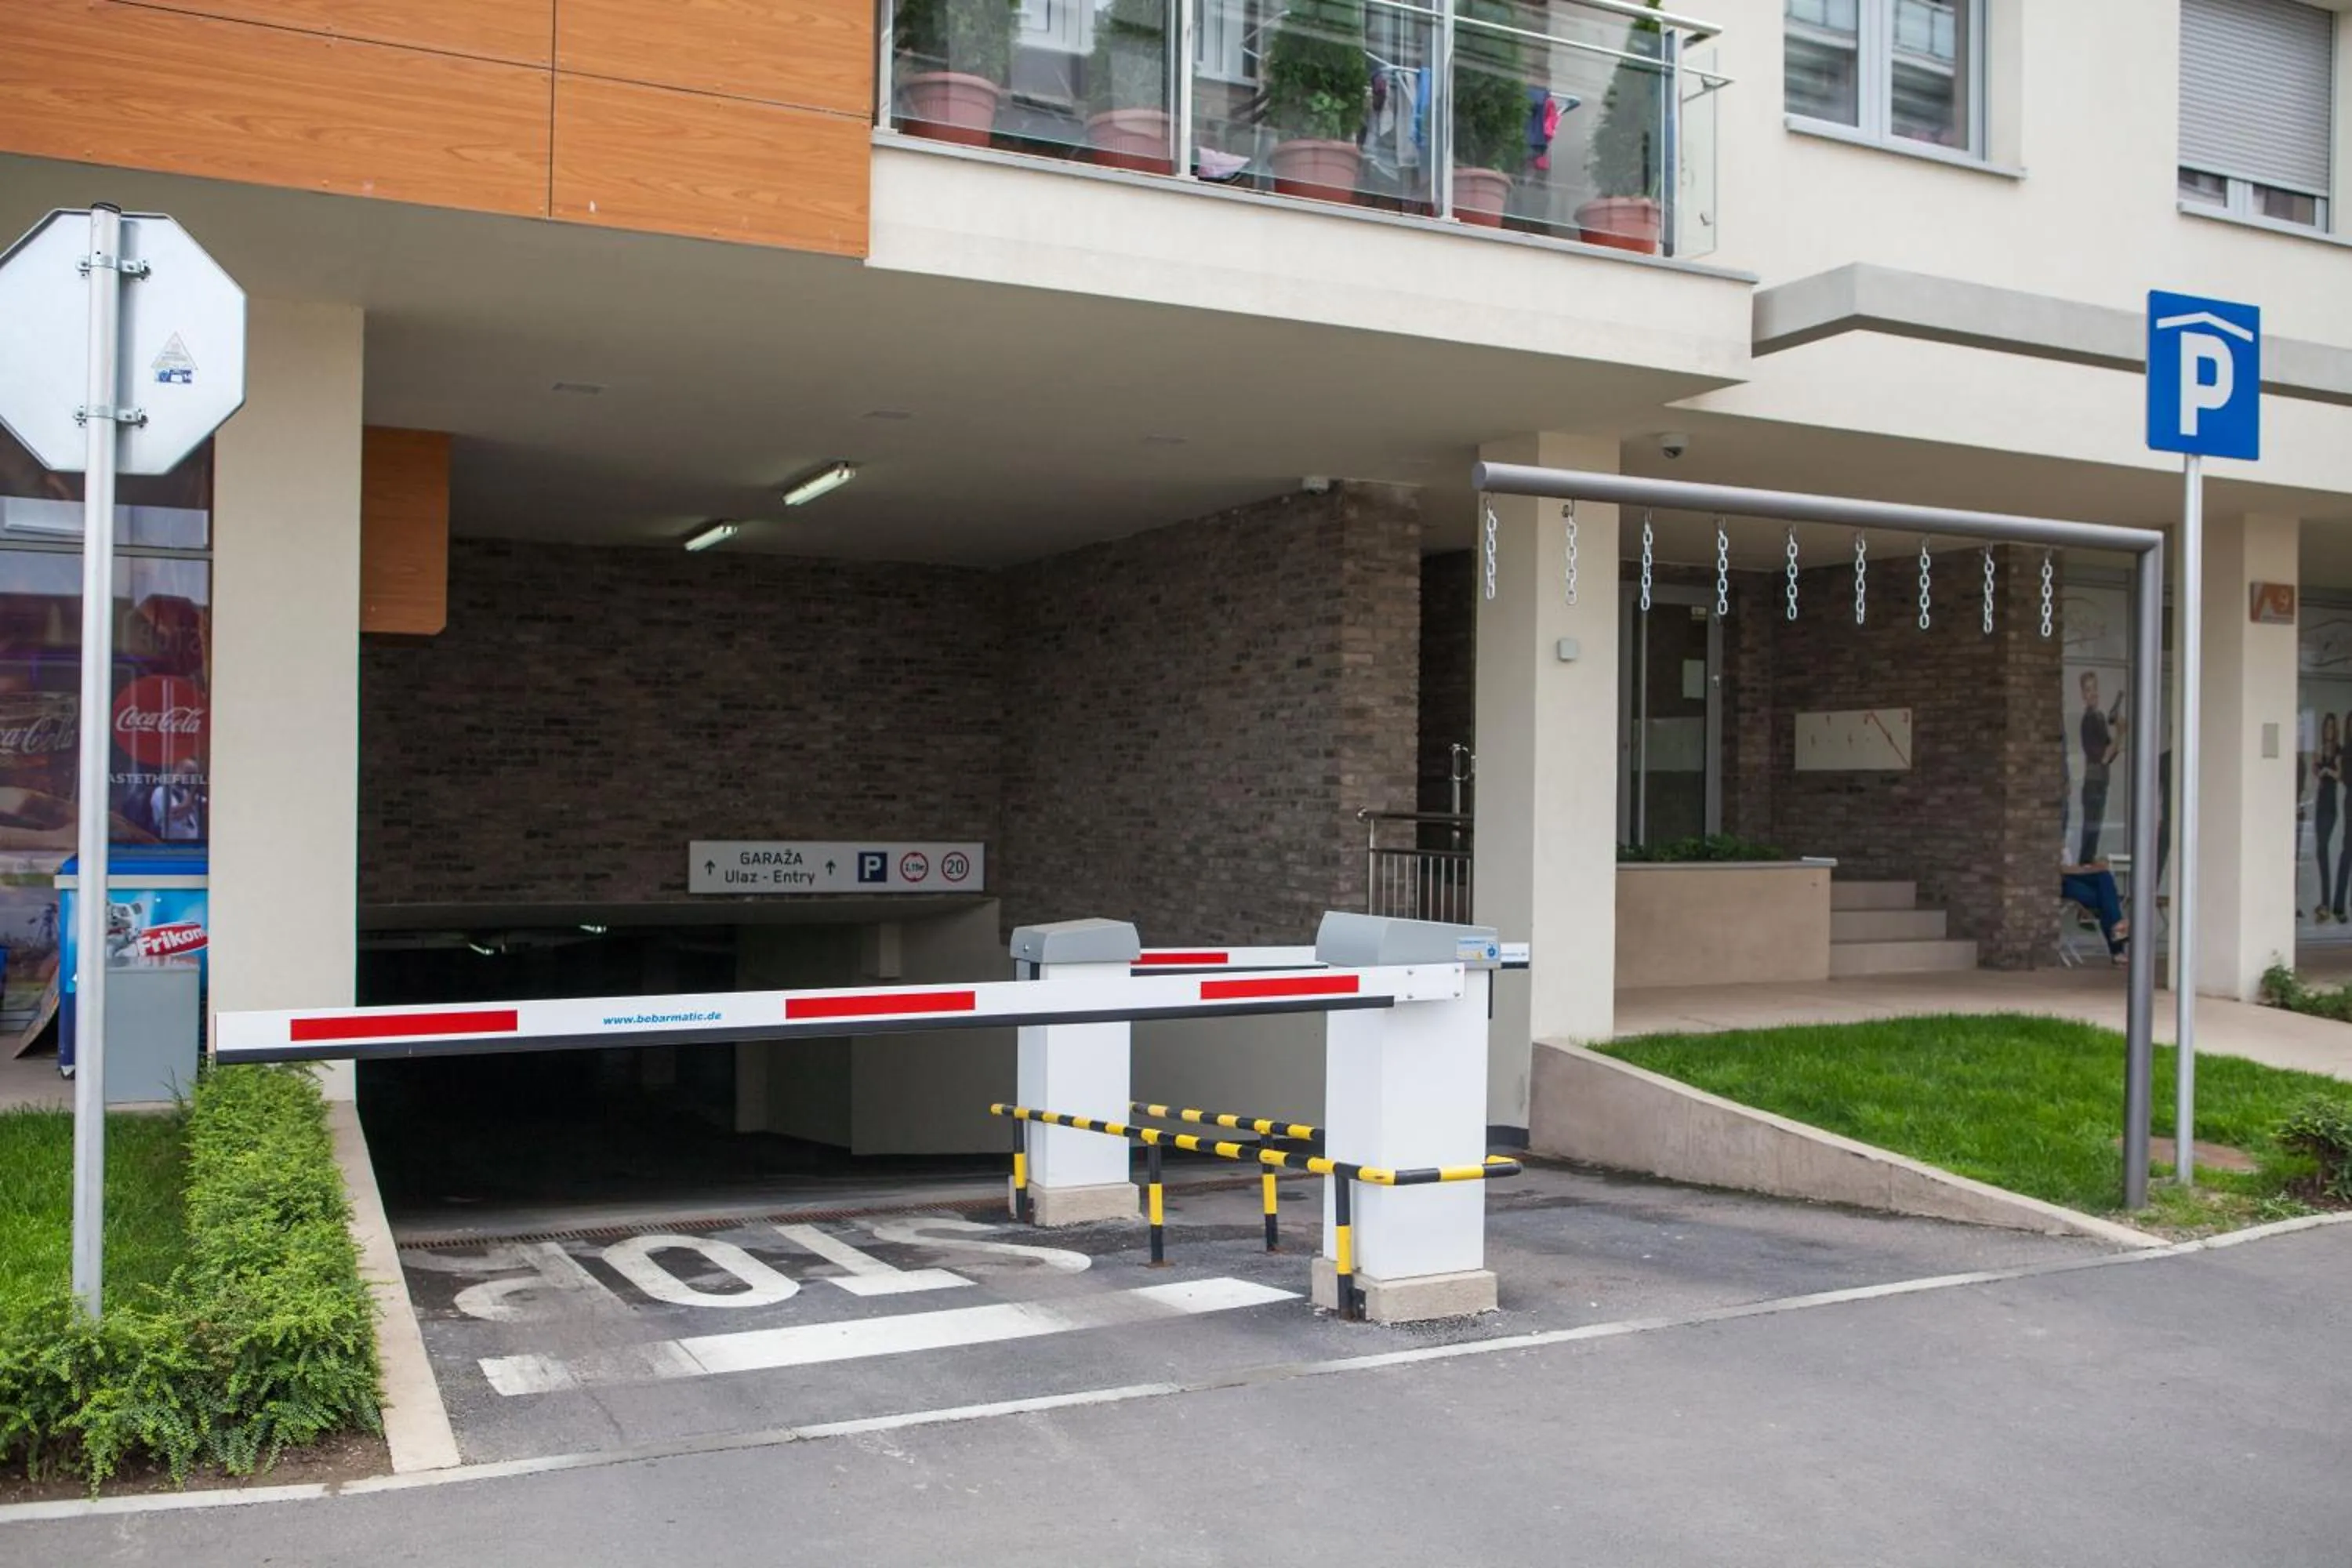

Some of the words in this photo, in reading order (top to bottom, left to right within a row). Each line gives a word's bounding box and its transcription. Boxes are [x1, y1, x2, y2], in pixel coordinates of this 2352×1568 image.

[2180, 331, 2234, 436] P
[740, 848, 803, 865] GARAŽA
[864, 855, 882, 879] P
[946, 859, 964, 874] 20
[724, 869, 758, 884] Ulaz
[773, 869, 815, 886] Entry
[603, 1011, 722, 1025] www.bebarmatic.de
[453, 1217, 1092, 1323] STOP
